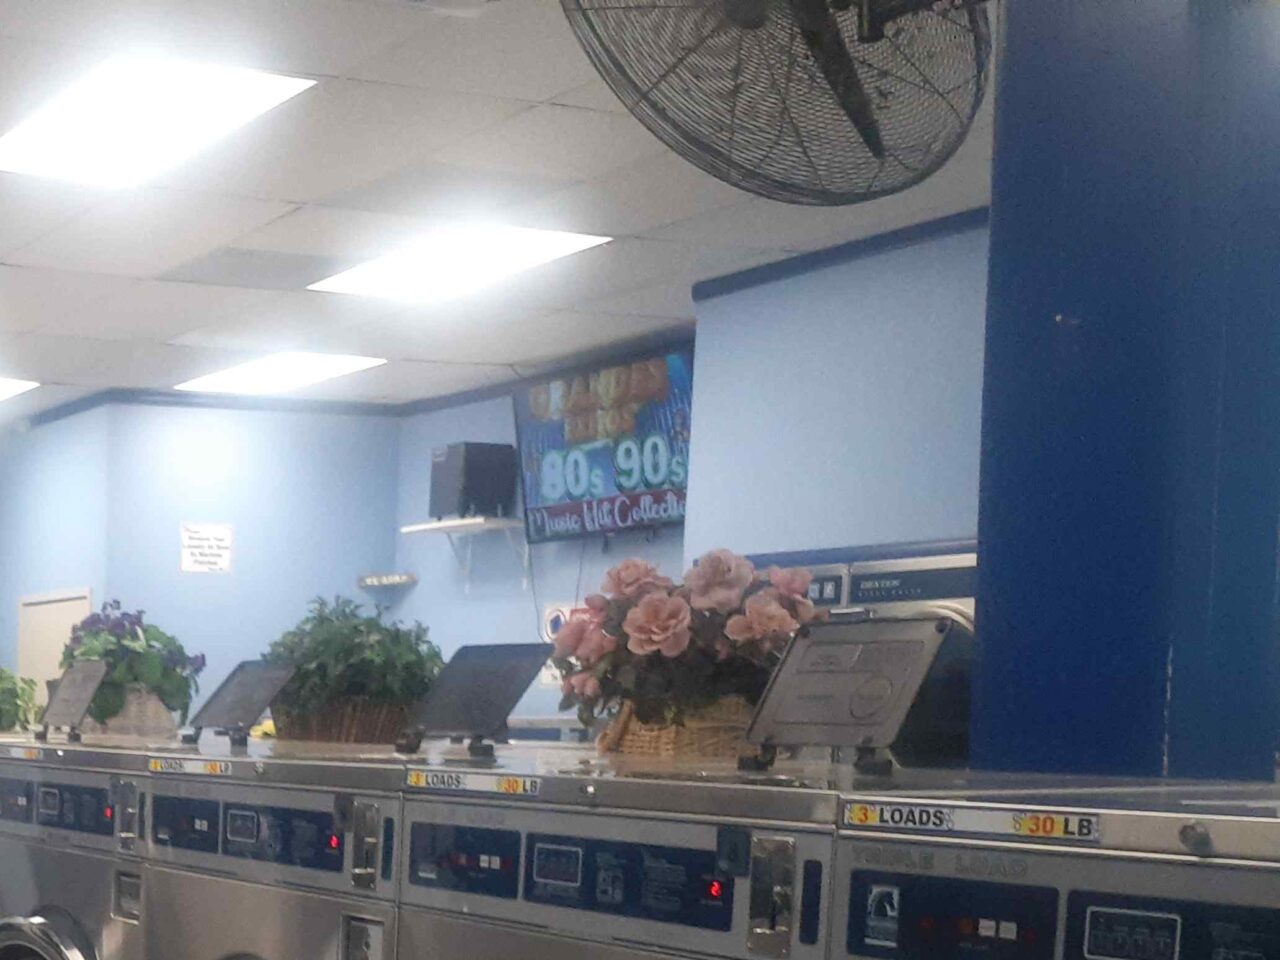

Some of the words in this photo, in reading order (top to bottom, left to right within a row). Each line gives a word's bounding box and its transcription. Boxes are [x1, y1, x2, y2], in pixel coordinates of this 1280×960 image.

[541, 447, 603, 499] 80s
[615, 435, 687, 492] 90s
[528, 508, 580, 538] Music
[582, 499, 612, 532] Hit
[425, 773, 462, 788] LOADS
[504, 777, 518, 794] 30
[522, 779, 538, 794] LB
[858, 806, 869, 824] 3
[879, 807, 945, 827] LOADS
[1028, 815, 1056, 835] 30
[1063, 817, 1093, 837] LB
